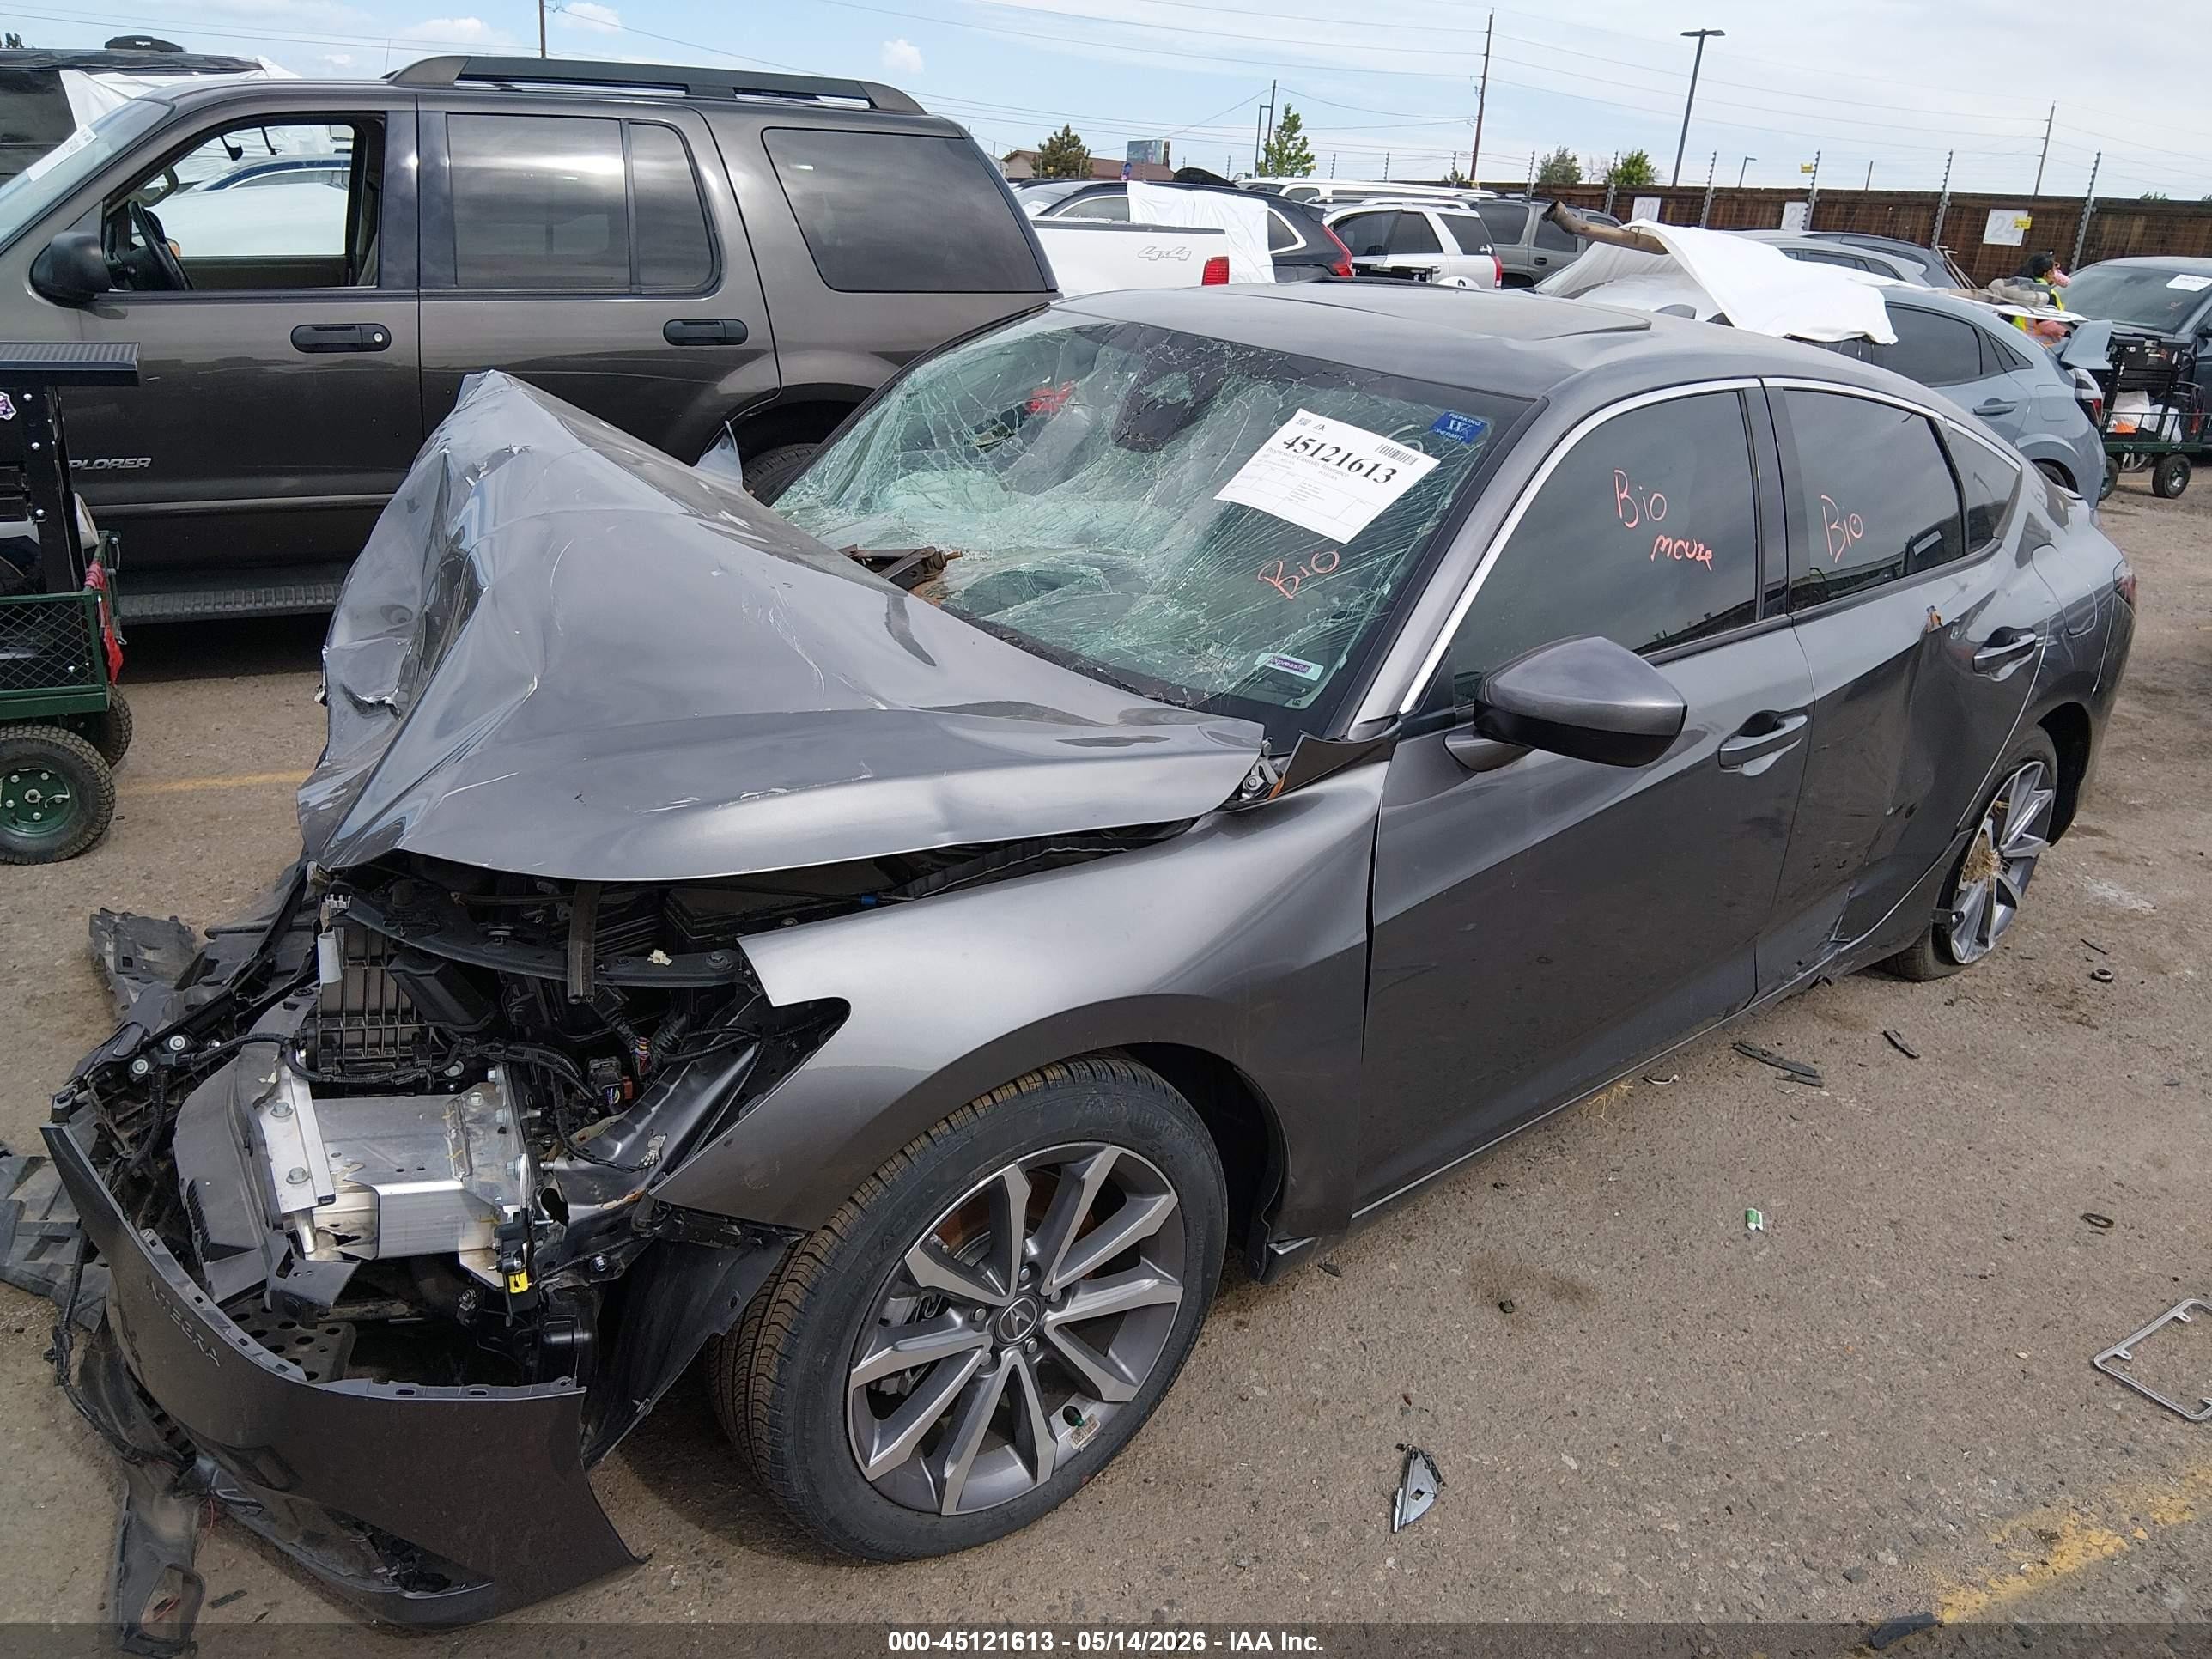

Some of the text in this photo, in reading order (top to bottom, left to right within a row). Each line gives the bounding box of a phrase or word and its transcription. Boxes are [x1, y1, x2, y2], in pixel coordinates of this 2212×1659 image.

[1138, 246, 1192, 261] 4x4
[69, 457, 152, 471] PLORER
[1283, 434, 1398, 483] 45121613
[1614, 469, 1668, 528] Bio
[1820, 494, 1863, 564] Bio
[1257, 550, 1340, 600] Bio
